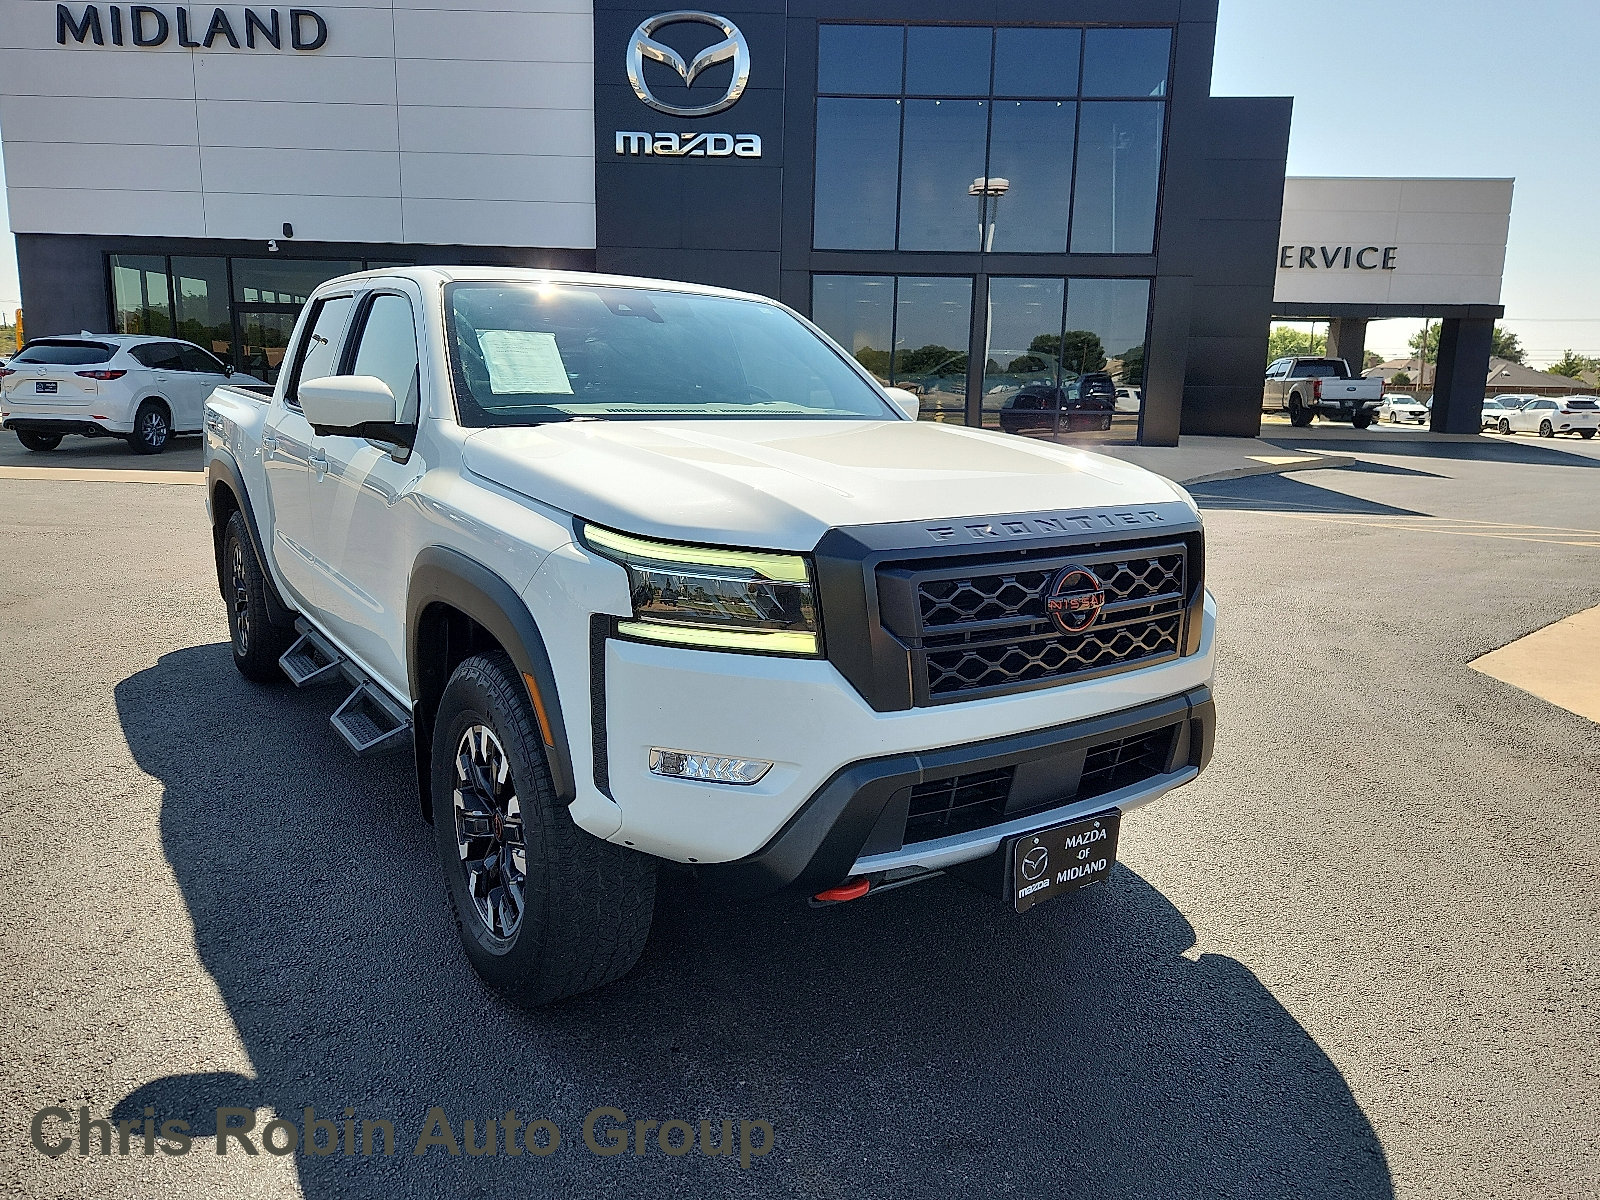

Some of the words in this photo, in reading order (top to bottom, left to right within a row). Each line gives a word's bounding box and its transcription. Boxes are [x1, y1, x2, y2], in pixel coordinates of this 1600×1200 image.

[56, 3, 328, 51] MIDLAND
[615, 130, 762, 158] mazda
[1280, 245, 1398, 270] ERVICE
[926, 510, 1164, 541] FRONTIER
[1065, 828, 1107, 849] MAZDA
[1078, 848, 1090, 859] OF
[1056, 859, 1107, 884] MIDLAND
[1019, 879, 1050, 898] mazda
